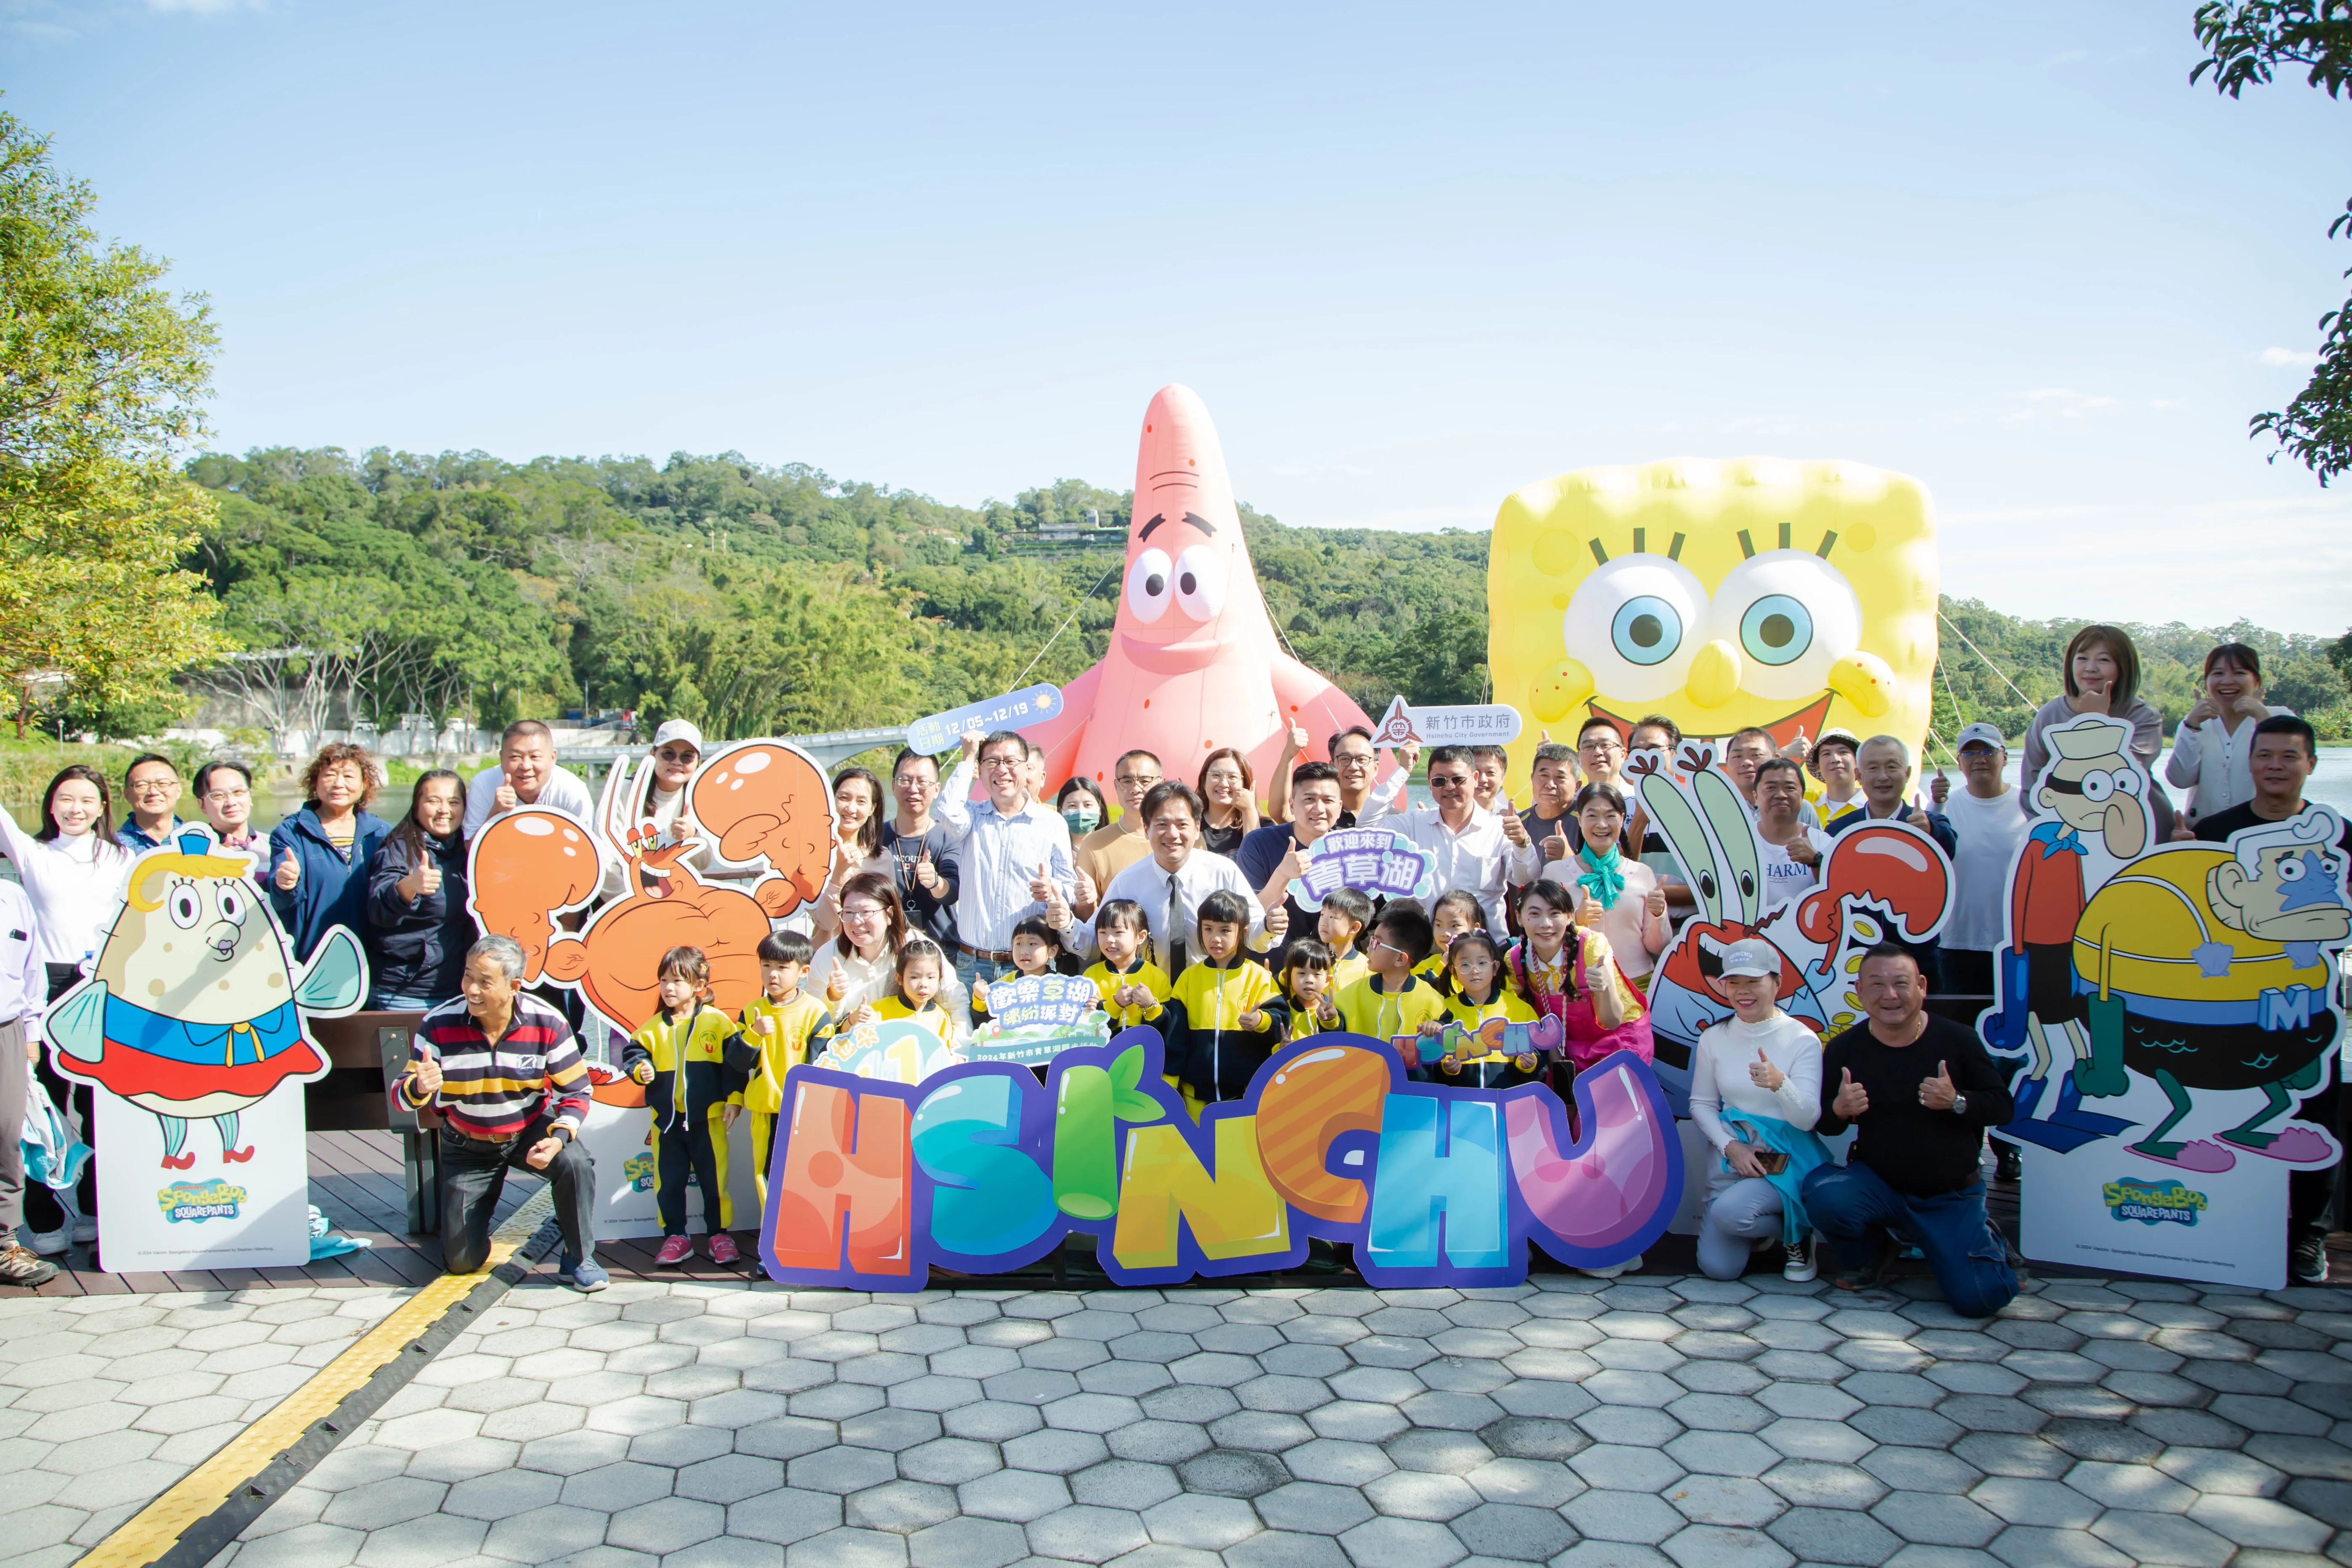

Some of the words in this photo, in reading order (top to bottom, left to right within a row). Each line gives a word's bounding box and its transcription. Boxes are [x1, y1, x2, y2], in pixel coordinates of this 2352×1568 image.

[916, 720, 941, 737] 活動
[945, 702, 1029, 735] 12/05~12/19
[1426, 714, 1510, 730] 新竹市政府
[919, 733, 945, 751] 日期
[1327, 832, 1393, 853] 歡迎來到
[1307, 853, 1418, 896] 青草湖
[991, 980, 1090, 1010] 歡樂草湖
[1003, 1002, 1078, 1025] 繽紛派對
[2258, 983, 2310, 1032] M
[1393, 1014, 1561, 1068] HSINCHU
[772, 1045, 1668, 1271] HSINCHU
[175, 1204, 234, 1218] SQUAREPANTS
[2122, 1205, 2191, 1221] SQUAREPANTS
